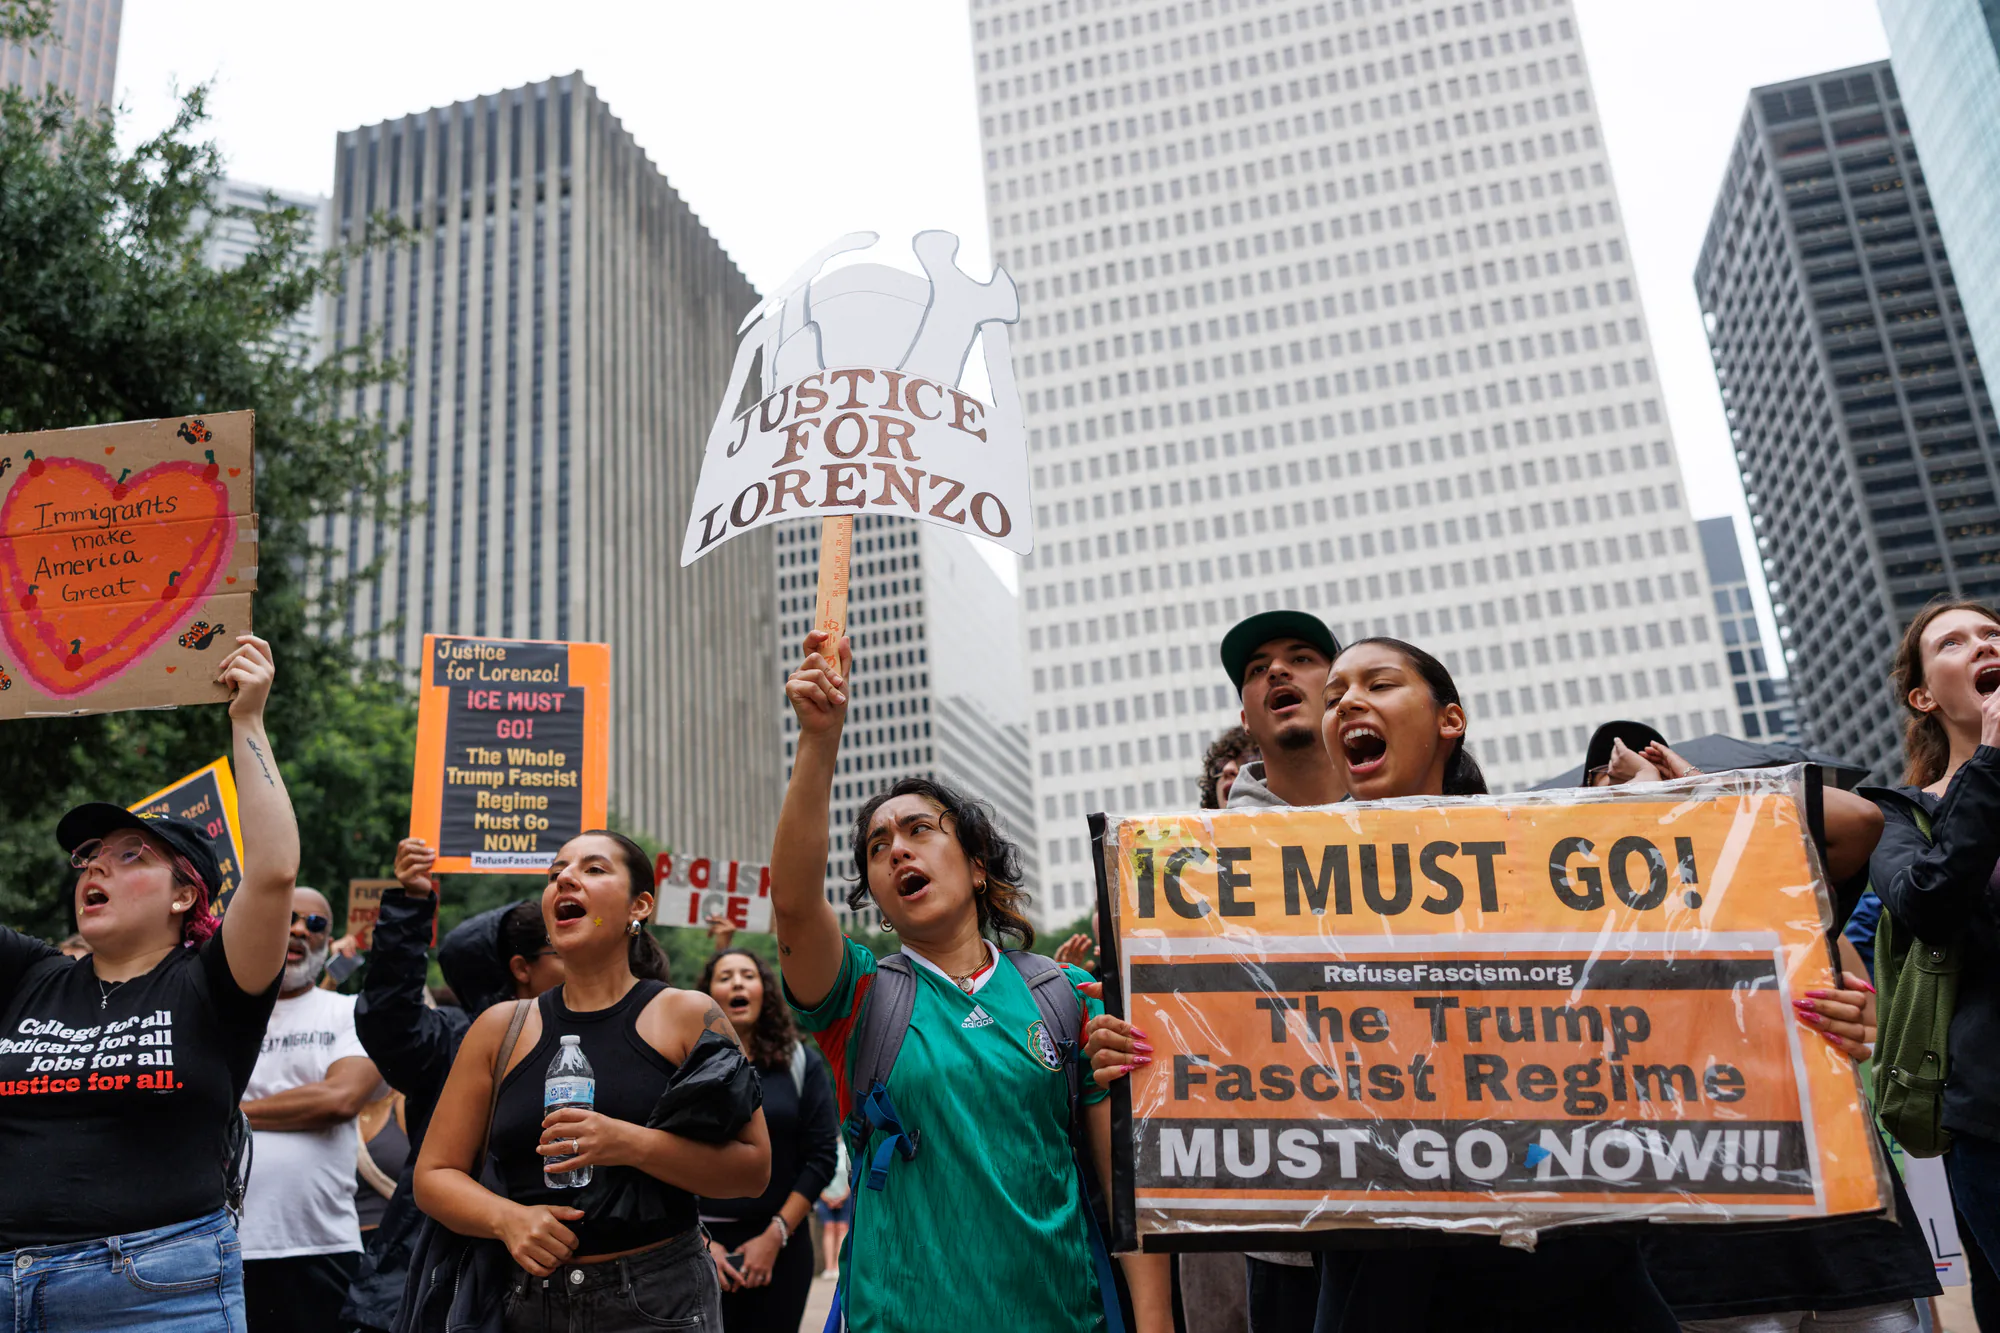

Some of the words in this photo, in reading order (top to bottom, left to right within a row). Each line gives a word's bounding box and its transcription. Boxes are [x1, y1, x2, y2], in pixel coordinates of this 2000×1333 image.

[726, 368, 988, 458] JUSTICE
[771, 412, 922, 468] FOR
[32, 495, 178, 531] Immigrants
[694, 462, 1012, 553] LORENZO
[71, 528, 137, 552] make
[34, 550, 143, 582] America
[61, 577, 137, 602] Great
[437, 641, 506, 661] Justice
[446, 660, 475, 681] for
[478, 662, 560, 683] Lorenzo!
[467, 690, 502, 710] ICE
[507, 691, 565, 712] MUST
[496, 718, 534, 739] GO!
[466, 747, 502, 766] The
[507, 748, 566, 767] Whole
[446, 767, 505, 789] Trump
[508, 768, 578, 787] Fascist
[476, 791, 549, 813] Regime
[474, 813, 520, 830] Must
[524, 814, 549, 831] Go
[484, 834, 538, 852] NOW!
[475, 856, 554, 865] RefuseFascism.
[1136, 846, 1256, 919] ICE
[1282, 840, 1507, 917] MUST
[1549, 835, 1703, 912] GO!
[688, 892, 750, 929] ICE
[1323, 963, 1575, 986] RefuseFascism.org
[18, 1018, 101, 1042] College
[104, 1015, 140, 1034] for
[140, 1010, 172, 1028] all
[961, 1017, 994, 1028] adidas
[1255, 994, 1390, 1044] The
[1413, 995, 1651, 1060] Trump
[97, 1034, 137, 1051] for
[138, 1029, 173, 1046] all
[26, 1056, 86, 1072] Jobs
[90, 1053, 133, 1069] for
[137, 1049, 174, 1066] all
[0, 1075, 81, 1096] ustice
[87, 1072, 131, 1091] for
[136, 1070, 184, 1090] all.
[1173, 1052, 1436, 1103] Fascist
[1465, 1052, 1748, 1116] Regime
[1159, 1126, 1370, 1180] MUST
[1398, 1127, 1509, 1182] GO
[1537, 1128, 1780, 1182] NOW!!!
